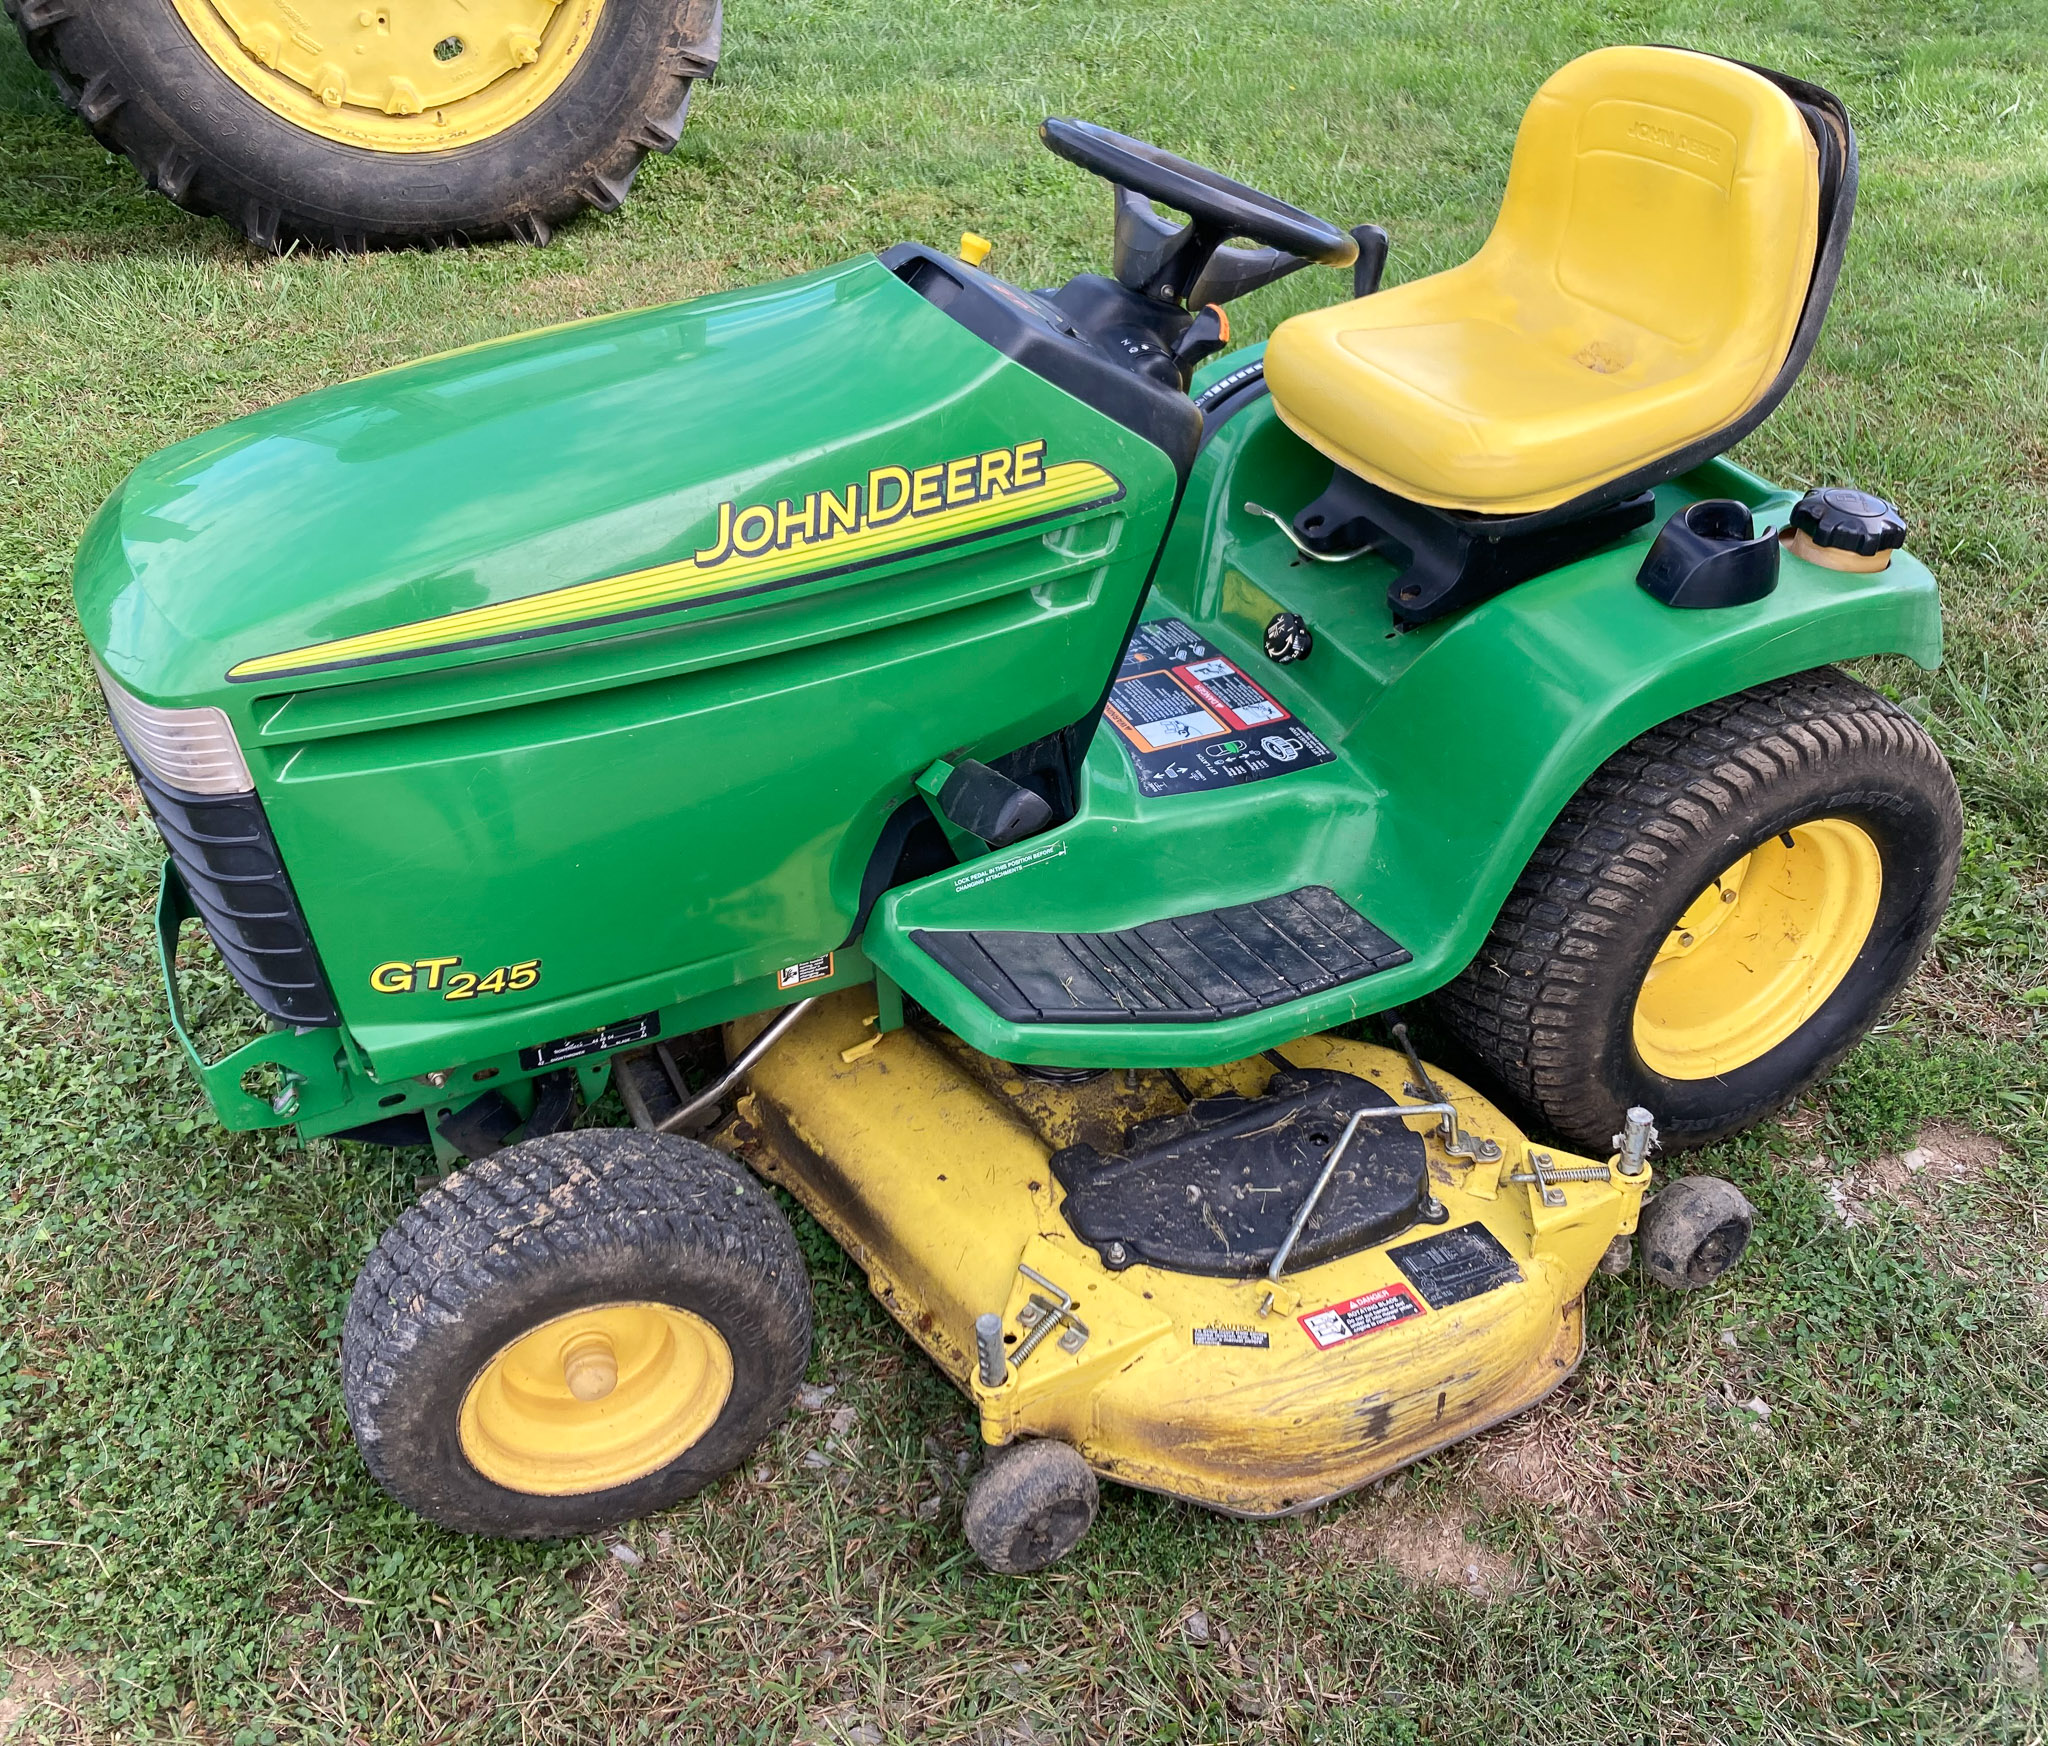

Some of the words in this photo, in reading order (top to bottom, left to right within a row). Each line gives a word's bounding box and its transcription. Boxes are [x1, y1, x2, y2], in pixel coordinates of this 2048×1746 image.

[1626, 120, 1673, 149] JOHN
[1676, 132, 1721, 165] DEERE
[694, 486, 862, 568] JOHN
[868, 439, 1047, 530] DEERE
[1193, 684, 1220, 704] DANGER
[954, 877, 970, 887] LOCK
[970, 871, 988, 881] PEDAL
[1007, 854, 1033, 867] POSITION
[1032, 847, 1054, 859] BEFORE
[955, 878, 985, 893] CHANGING
[985, 865, 1023, 883] ATTACHMENTS
[1357, 1289, 1390, 1306] DANGER
[1214, 1321, 1257, 1332] CAUTION
